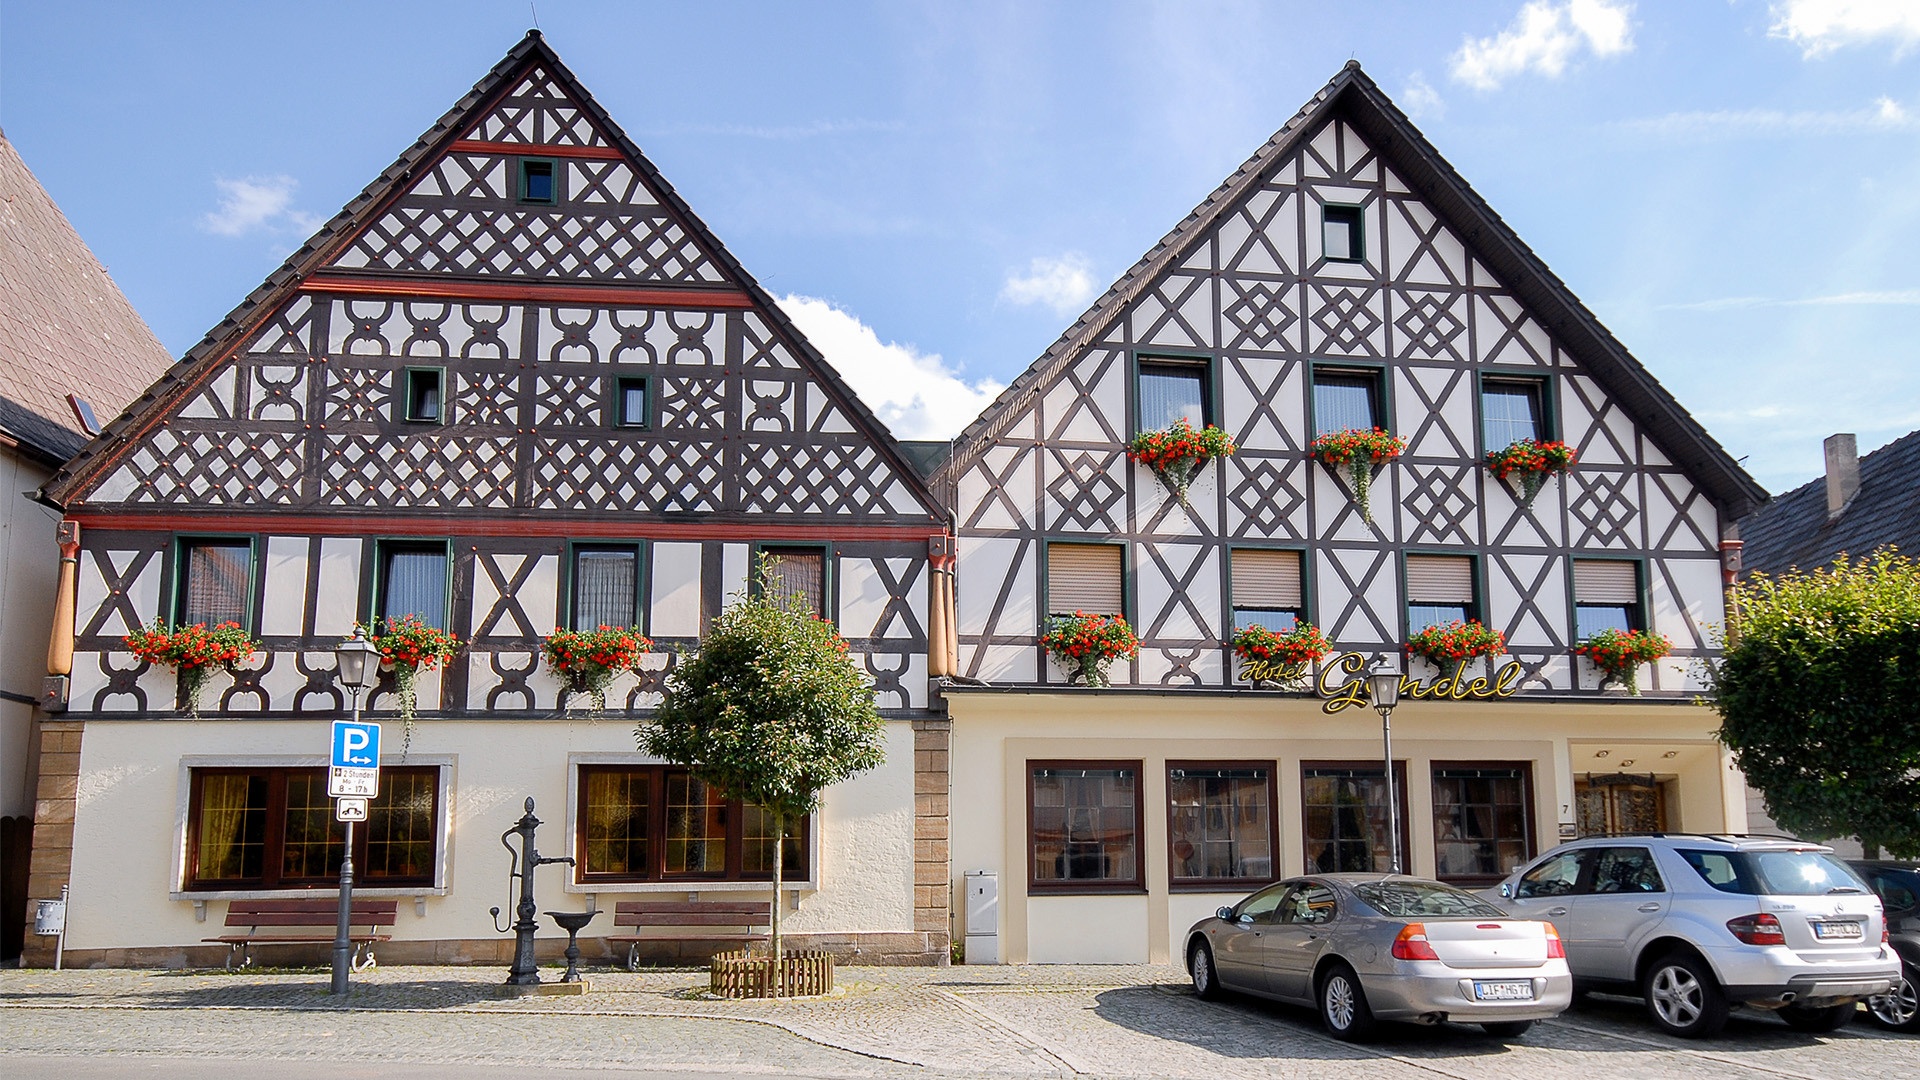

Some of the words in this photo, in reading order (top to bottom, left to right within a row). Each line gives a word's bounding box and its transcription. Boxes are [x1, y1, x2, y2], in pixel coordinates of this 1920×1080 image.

[1240, 659, 1310, 681] Hotel
[1318, 652, 1521, 713] Gndel
[343, 728, 370, 763] P
[343, 770, 348, 778] 2
[349, 770, 374, 779] Stunden
[339, 785, 345, 793] 8
[1563, 805, 1569, 814] 7
[1482, 984, 1499, 995] LIF
